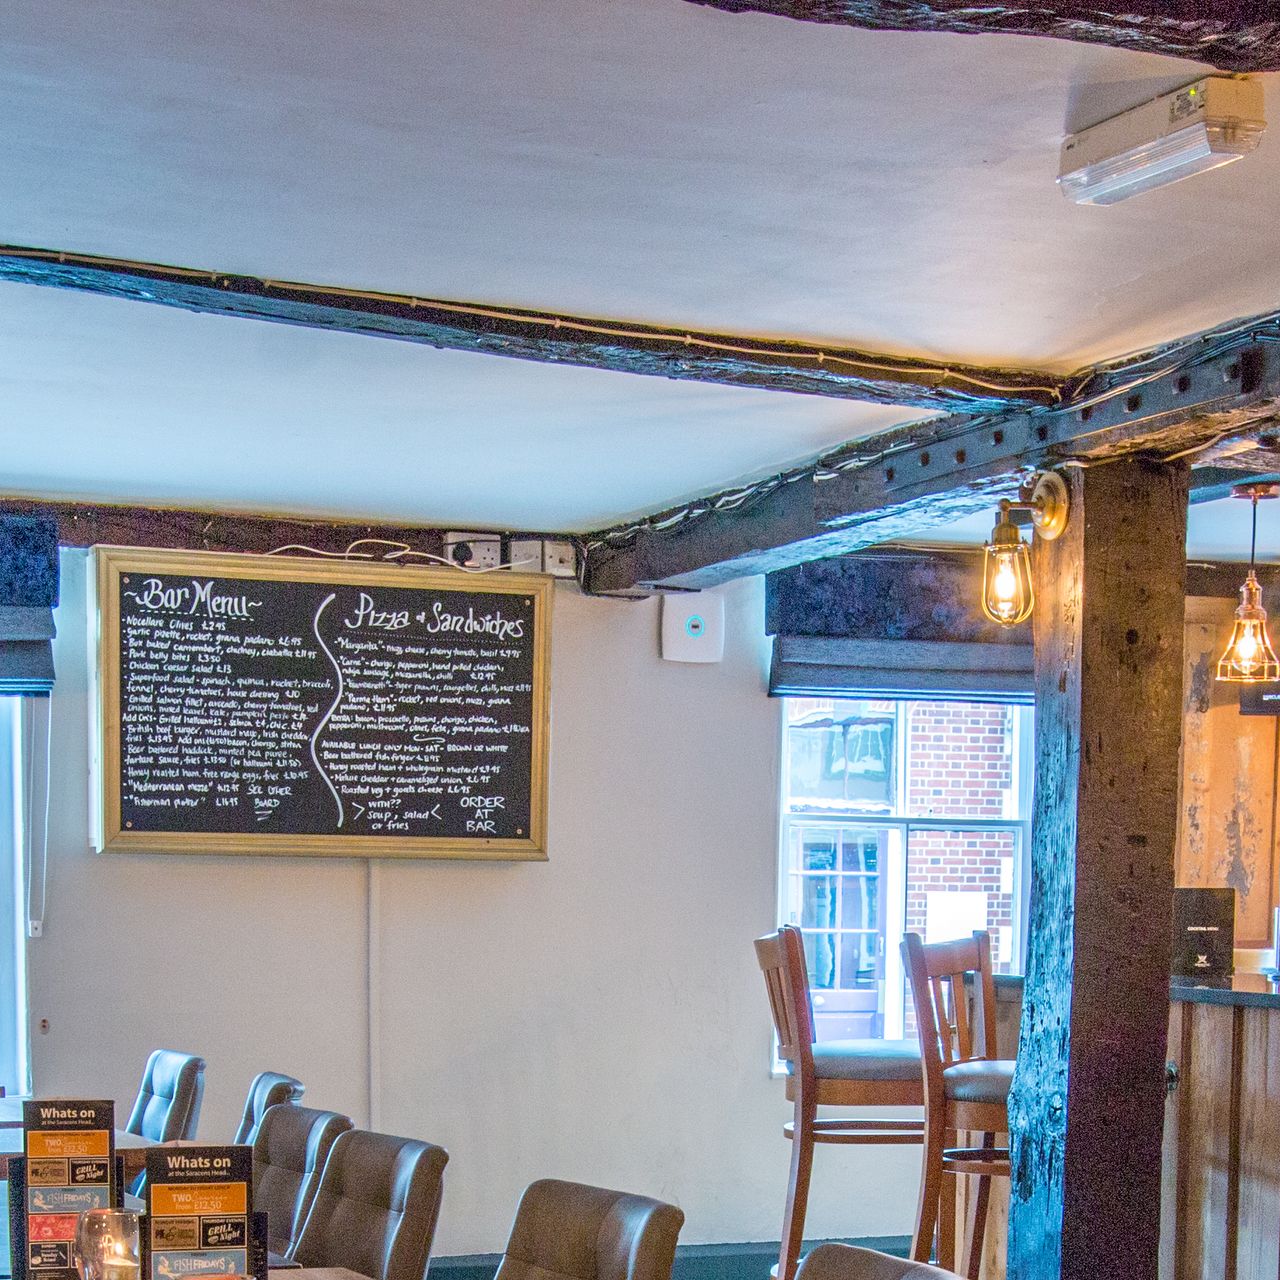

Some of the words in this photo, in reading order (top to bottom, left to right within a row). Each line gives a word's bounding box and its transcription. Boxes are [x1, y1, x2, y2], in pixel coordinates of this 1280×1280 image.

[343, 592, 412, 631] Pizza
[426, 602, 525, 641] Sandwiches
[460, 795, 506, 809] ORDER
[402, 810, 430, 820] salad
[474, 808, 495, 820] AT
[371, 822, 383, 831] or
[386, 819, 409, 831] fries
[466, 820, 497, 834] BAR
[40, 1107, 78, 1119] Whats
[79, 1109, 96, 1118] on
[166, 1156, 211, 1169] Whats
[213, 1157, 232, 1168] on
[172, 1193, 192, 1203] TWO
[208, 1223, 233, 1236] GRILL
[219, 1230, 241, 1241] Night
[193, 1257, 226, 1271] FRIDAYS
